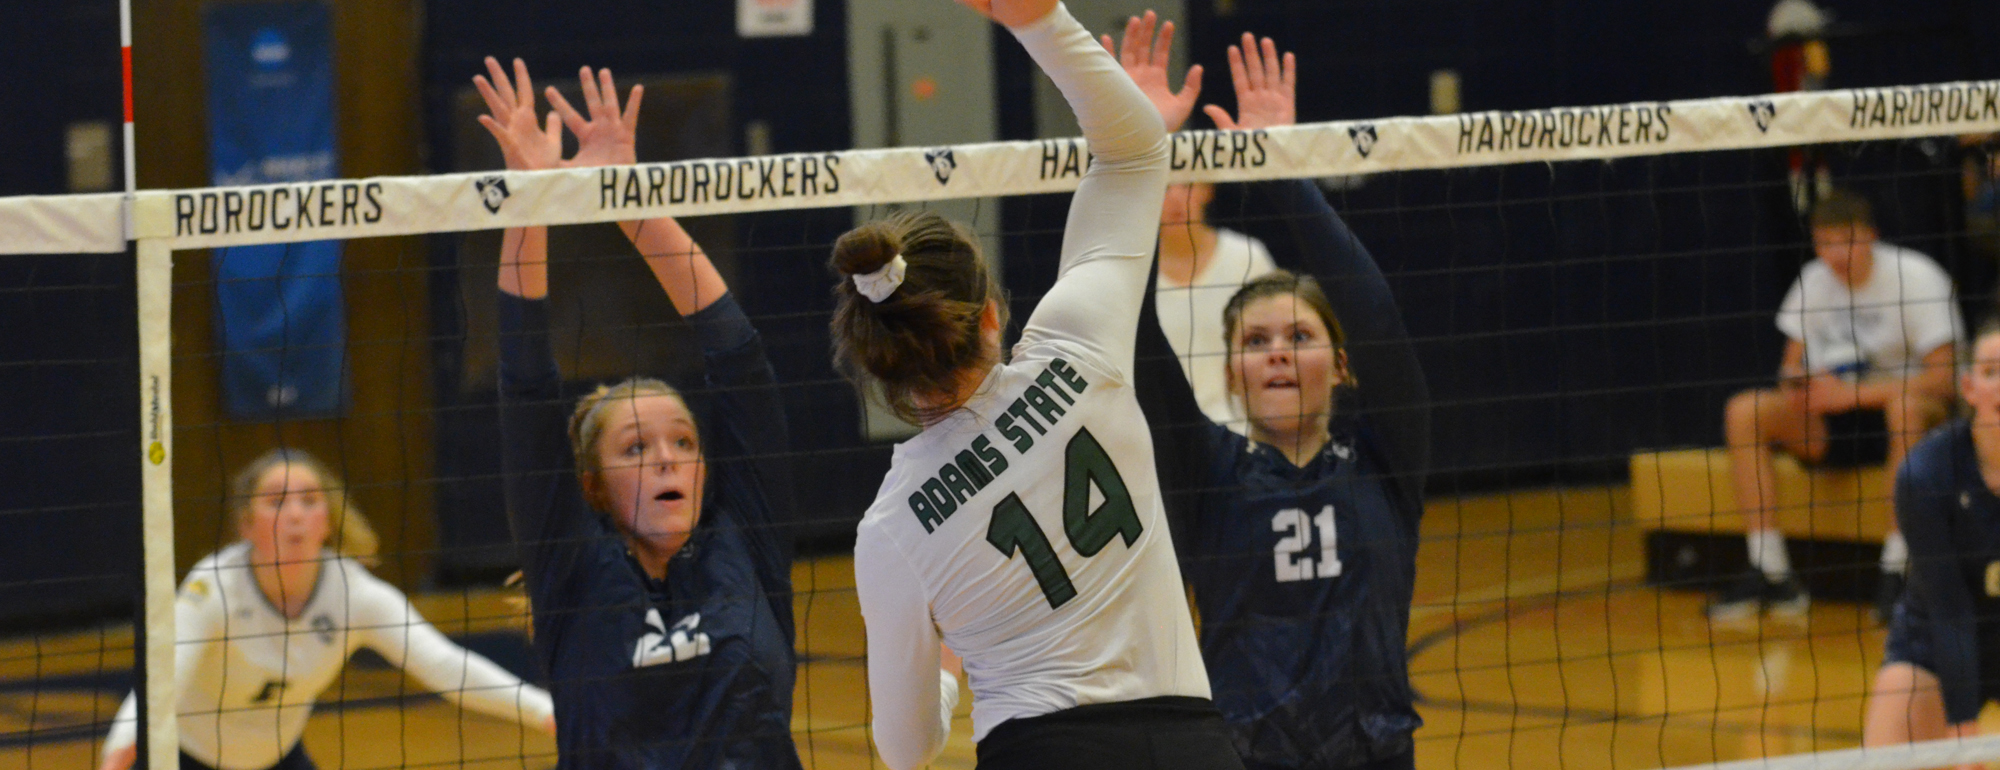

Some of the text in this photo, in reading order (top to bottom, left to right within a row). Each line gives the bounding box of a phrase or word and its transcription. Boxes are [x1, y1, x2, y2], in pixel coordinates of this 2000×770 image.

[175, 83, 2000, 237] RDROCKERS HARDROCKERS HACKERS HARDROCKERS HARDROCK
[908, 357, 1088, 535] ADAMS STATE
[986, 426, 1144, 610] 14
[1271, 504, 1342, 582] 21
